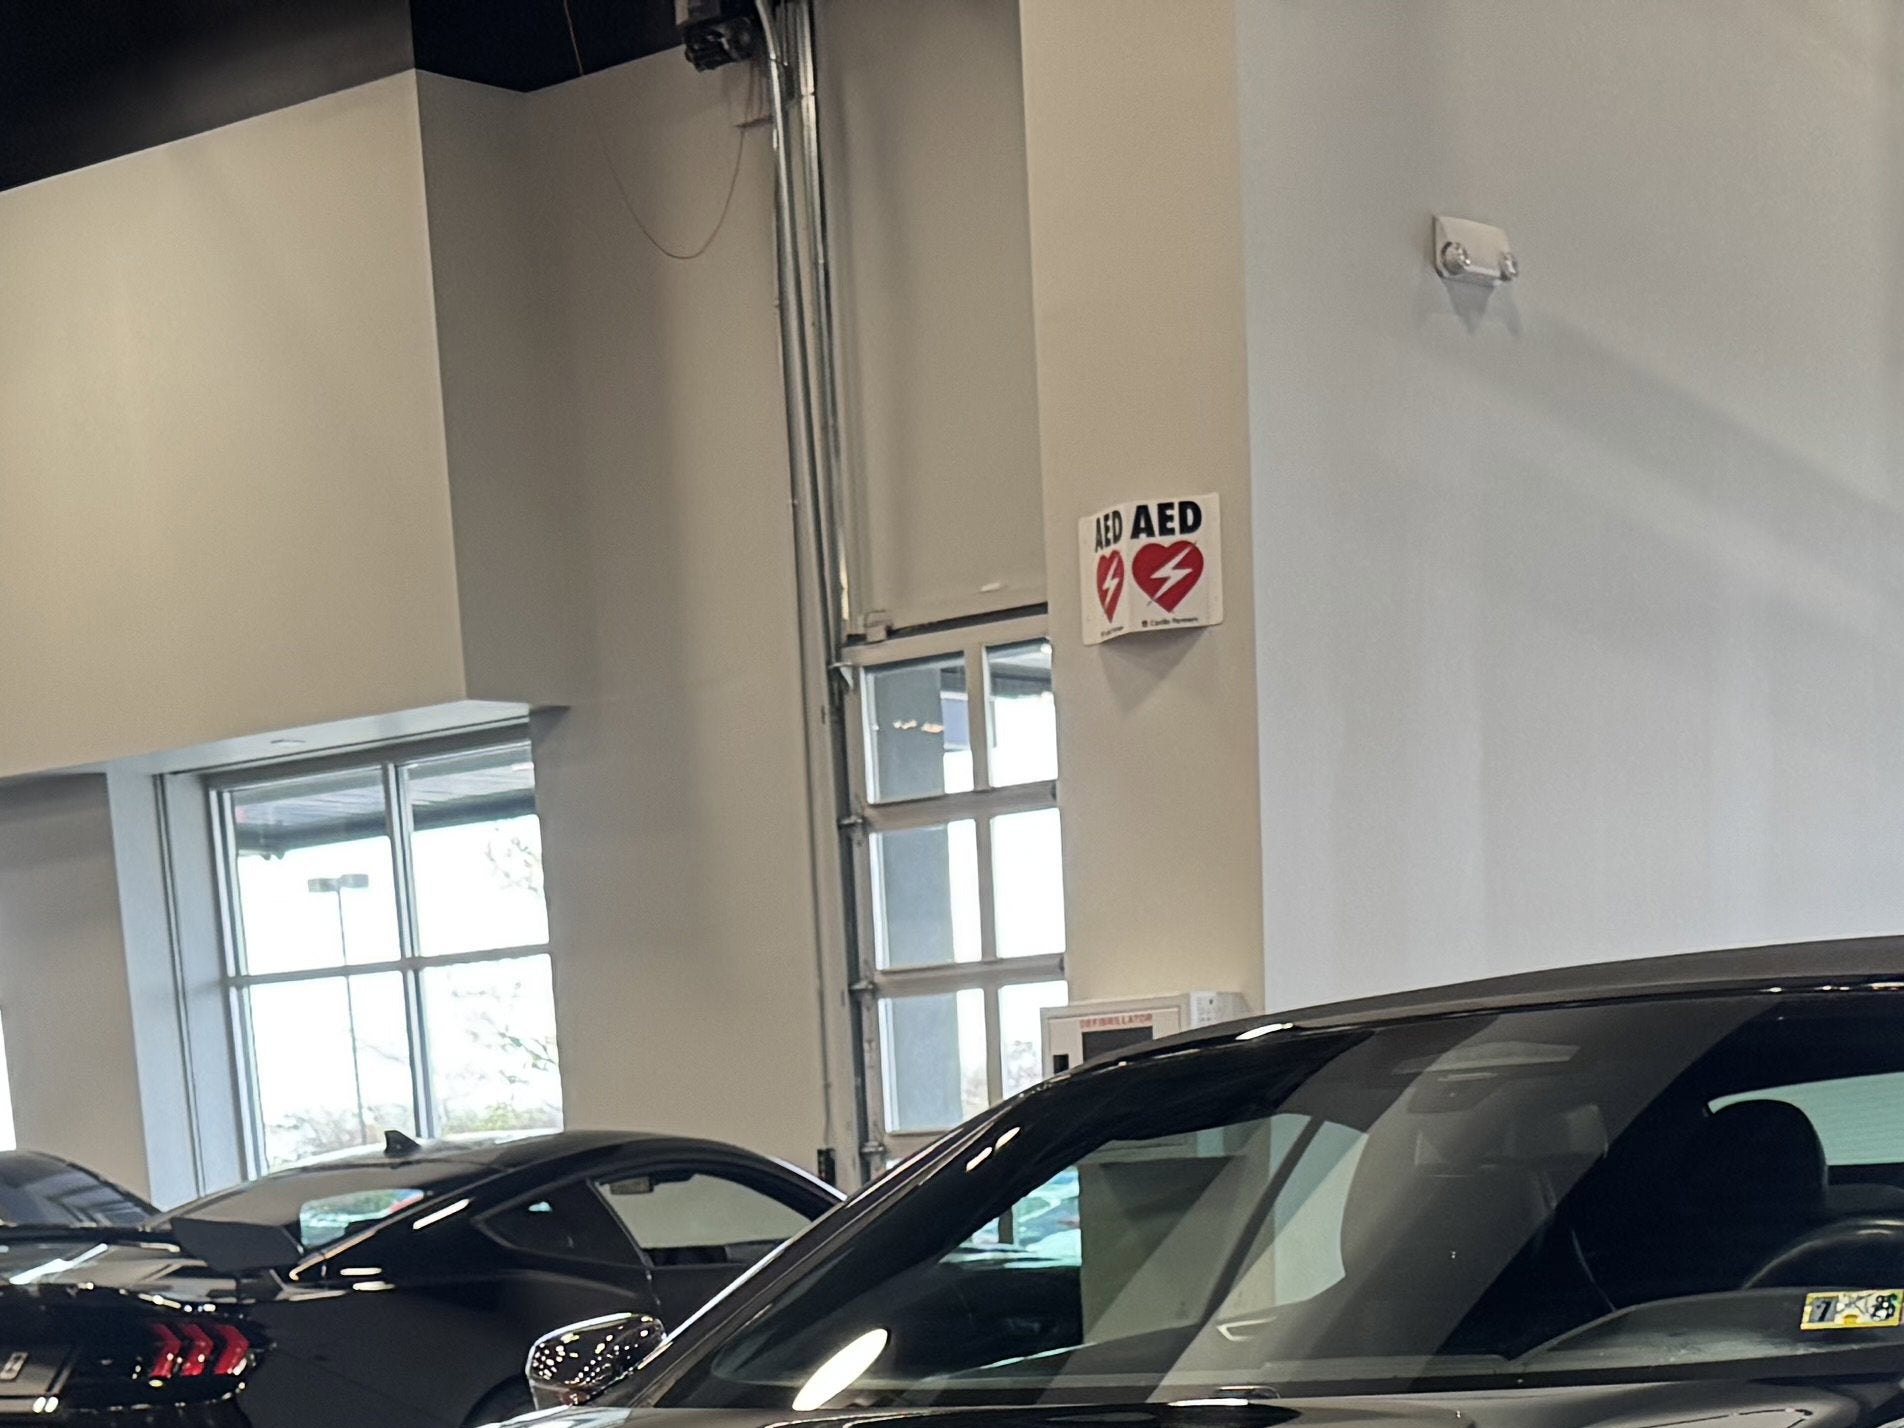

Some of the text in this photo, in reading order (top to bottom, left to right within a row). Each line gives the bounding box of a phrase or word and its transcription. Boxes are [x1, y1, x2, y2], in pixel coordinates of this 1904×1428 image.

[1095, 510, 1123, 553] AED
[1130, 501, 1202, 540] AED
[1079, 1013, 1153, 1029] DEFIBRILLATOR
